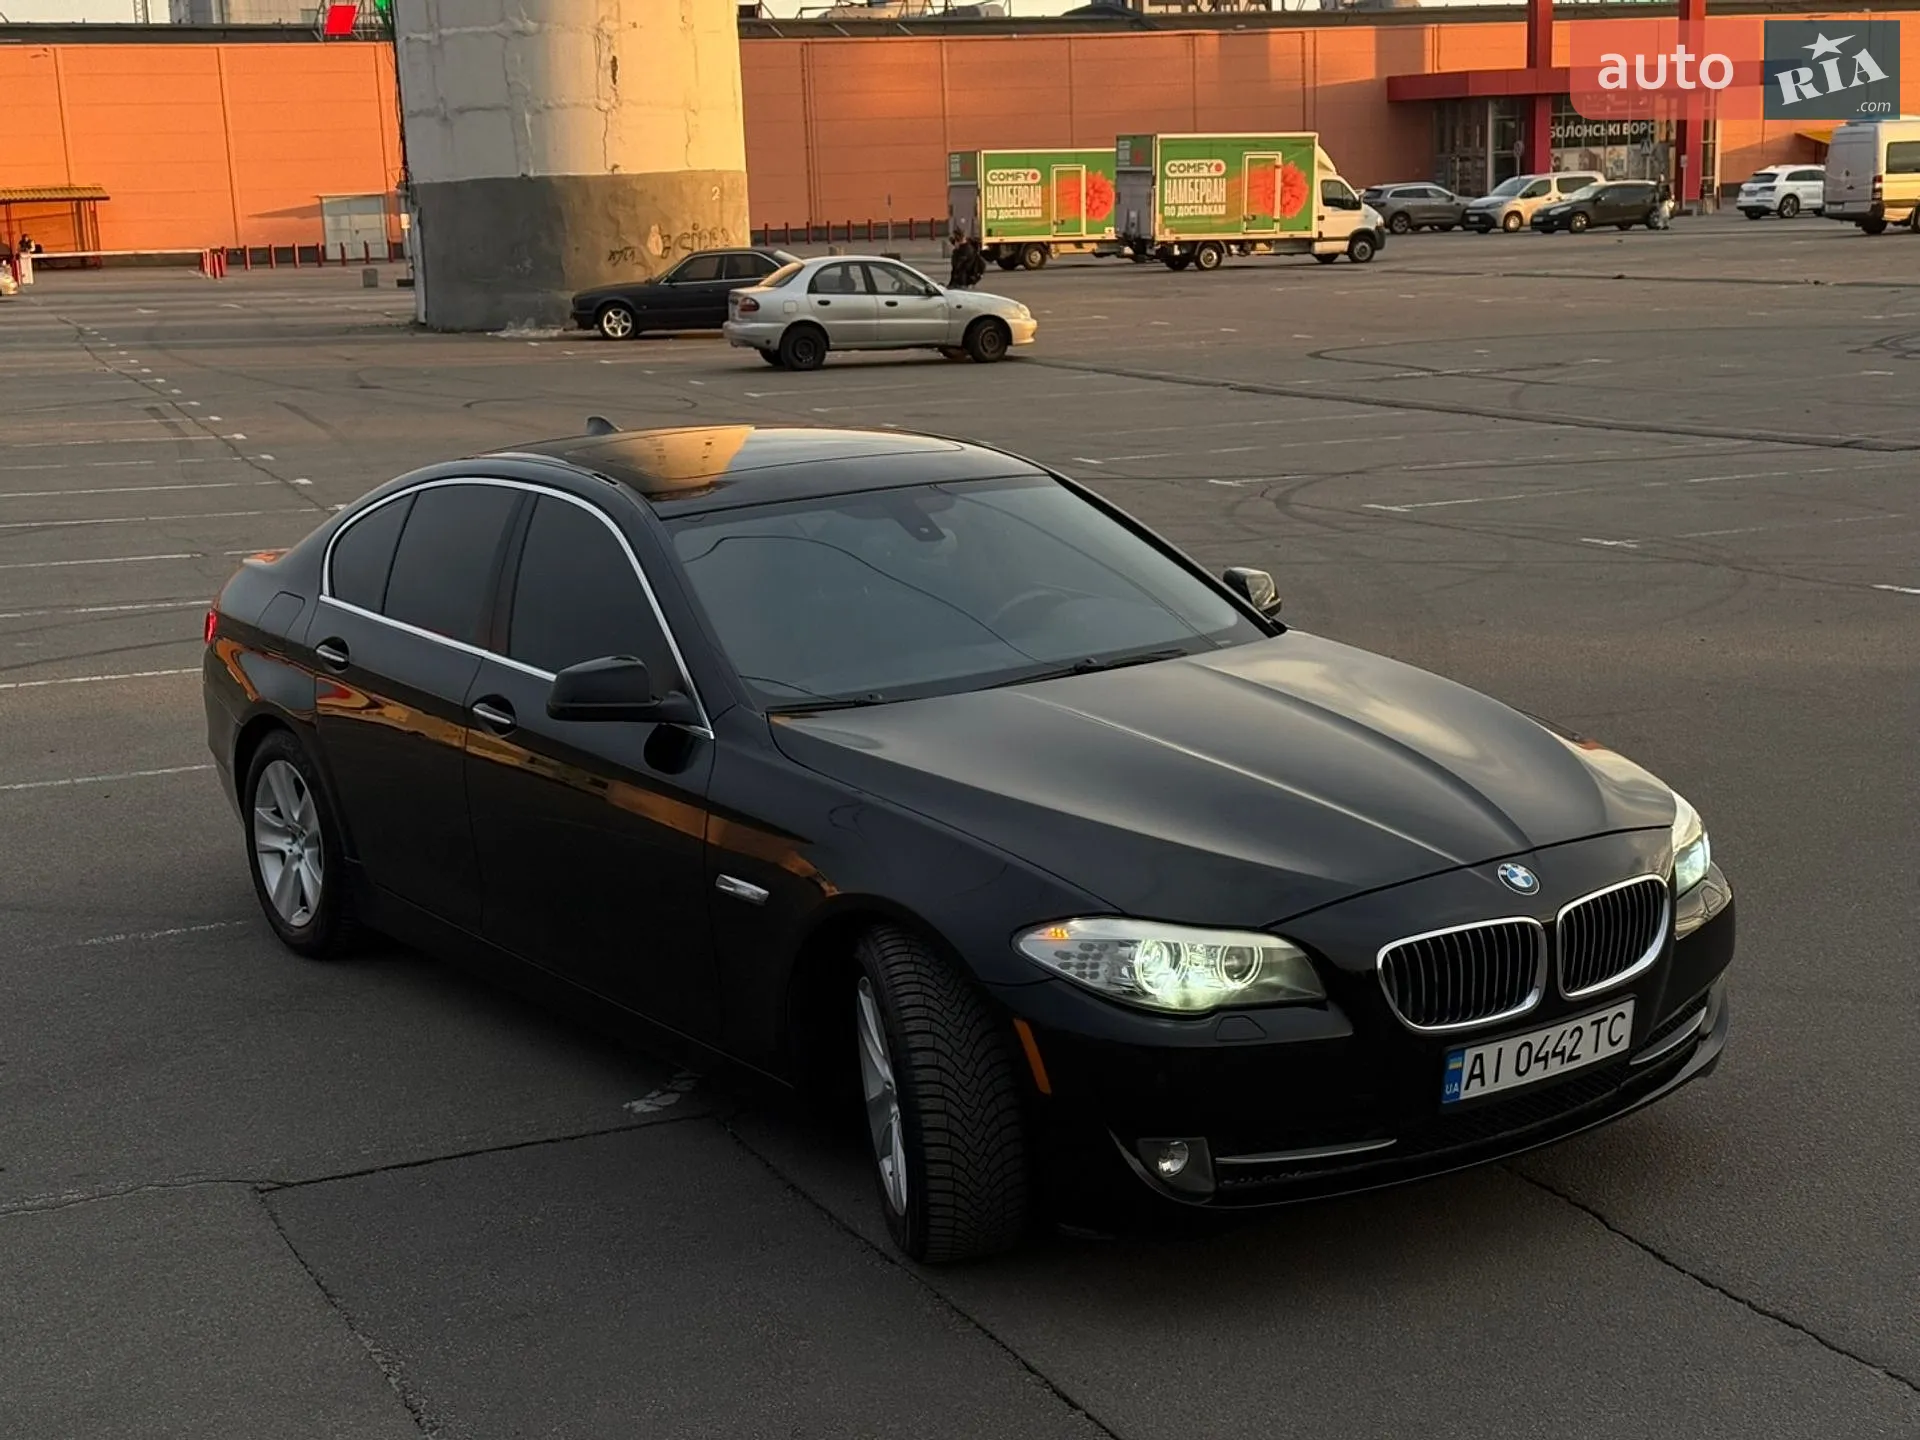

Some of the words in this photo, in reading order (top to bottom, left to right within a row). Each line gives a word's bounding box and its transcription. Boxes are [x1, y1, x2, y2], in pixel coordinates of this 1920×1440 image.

[1168, 162, 1214, 174] COMFY
[989, 172, 1030, 182] COMFY
[712, 186, 721, 201] 2
[986, 185, 1042, 207] НАМБЕРВАН
[1164, 178, 1226, 204] НАМБЕРВАН
[1177, 205, 1226, 217] ДОСТАВКАМ
[1464, 1047, 1503, 1091] AI
[1515, 1025, 1584, 1077] 0442
[1590, 1011, 1627, 1054] TC
[1445, 1084, 1460, 1095] UA
